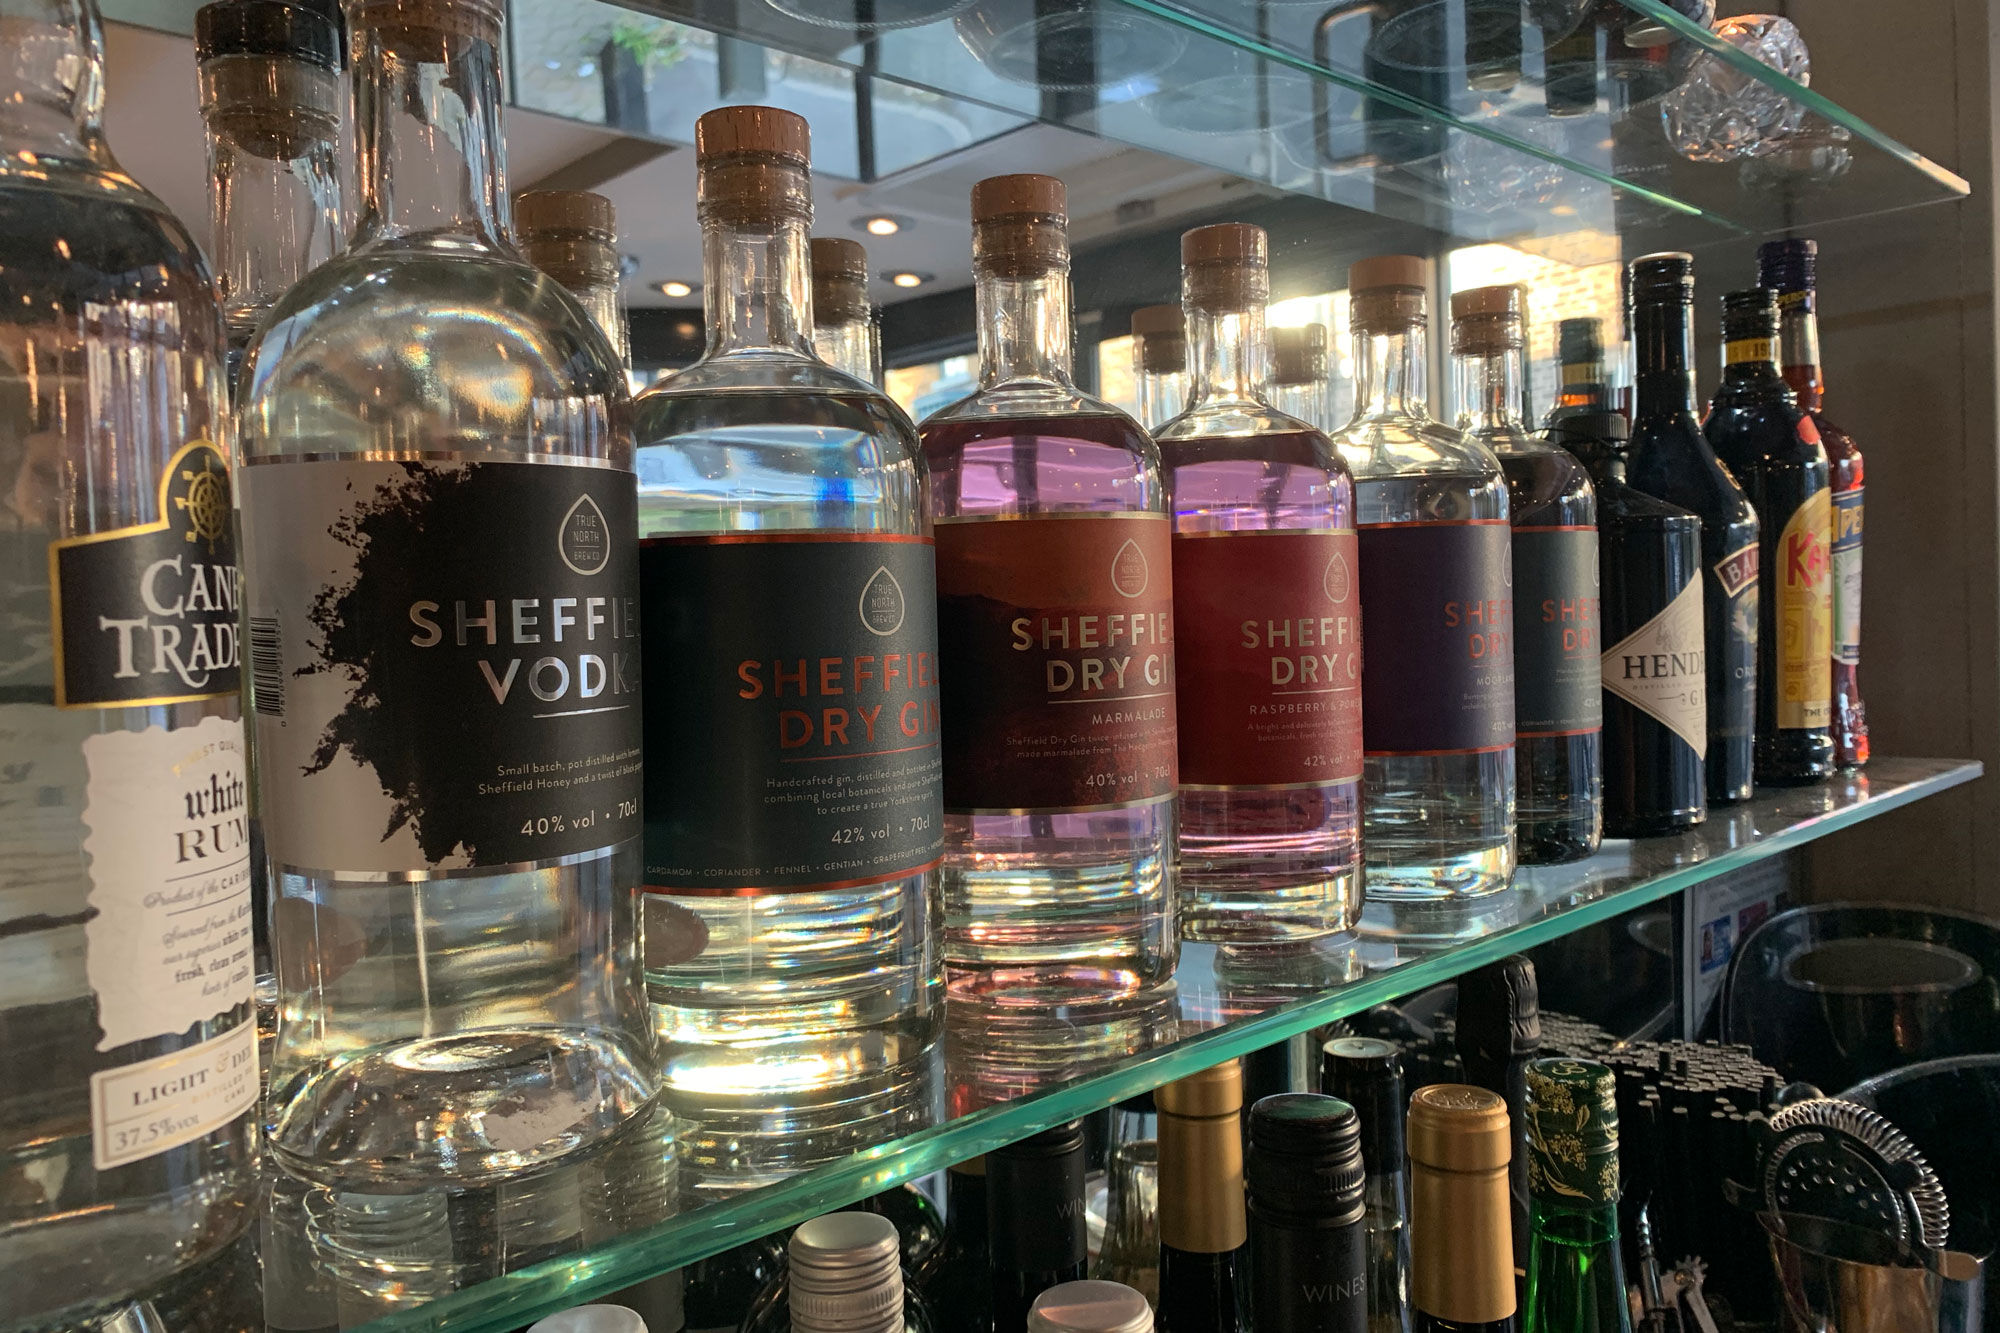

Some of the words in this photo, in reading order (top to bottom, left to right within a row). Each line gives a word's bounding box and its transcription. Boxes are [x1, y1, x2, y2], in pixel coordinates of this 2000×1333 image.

[575, 514, 597, 528] TRUE
[573, 531, 600, 543] NORTH
[873, 583, 893, 596] TRUE
[871, 597, 896, 609] NORTH
[409, 597, 641, 648] SHEFFIE
[1468, 631, 1510, 659] DRY
[1562, 627, 1599, 652] DRY
[478, 652, 639, 705] VODK
[1046, 656, 1131, 693] DRY
[1271, 653, 1338, 685] DRY
[1092, 707, 1166, 726] MARMALADE
[1249, 702, 1326, 715] RASPBERRY
[780, 704, 883, 750] DRY
[1006, 734, 1047, 746] Sheffield
[1050, 735, 1067, 746] Dry
[1070, 734, 1086, 744] Gin
[1017, 750, 1041, 759] made
[1043, 747, 1090, 758] marmalade
[1093, 746, 1112, 754] from
[497, 764, 530, 777] Small
[532, 760, 565, 774] batch,
[568, 760, 584, 772] pot
[586, 752, 615, 766] distilled
[1303, 754, 1327, 767] 42%
[1329, 754, 1343, 765] vol
[478, 779, 533, 795] Sheffield
[537, 778, 571, 790] Honey
[573, 773, 589, 785] and
[597, 768, 615, 781] twist
[616, 766, 622, 777] of
[766, 774, 833, 788] Handcrafted
[836, 773, 855, 787] gin,
[857, 769, 890, 782] distilled
[893, 766, 905, 777] and
[1086, 773, 1116, 788] 40%
[1121, 770, 1138, 784] vol
[1155, 764, 1171, 779] 70cl
[764, 792, 820, 804] combining
[822, 788, 846, 799] local
[848, 783, 892, 798] botanicals
[893, 779, 906, 791] and
[521, 814, 565, 837] 40%
[572, 809, 595, 829] vol
[618, 797, 637, 820] 70cl
[817, 806, 827, 815] to
[830, 803, 861, 814] create
[871, 801, 888, 809] true
[890, 796, 920, 807] Yorkshire
[831, 826, 866, 845] 42%
[871, 823, 890, 840] vol
[911, 814, 930, 833] 70cl
[646, 865, 693, 877] CARDAMOM
[703, 867, 761, 878] CORIANDER
[774, 865, 812, 876] FENNEL
[824, 859, 863, 872] GENTIAN
[873, 850, 915, 865] GRAPEFRUIT
[915, 846, 927, 856] PEEL
[132, 1066, 210, 1107] LIGHT
[215, 1048, 229, 1074] &
[1302, 1271, 1367, 1304] WINES
